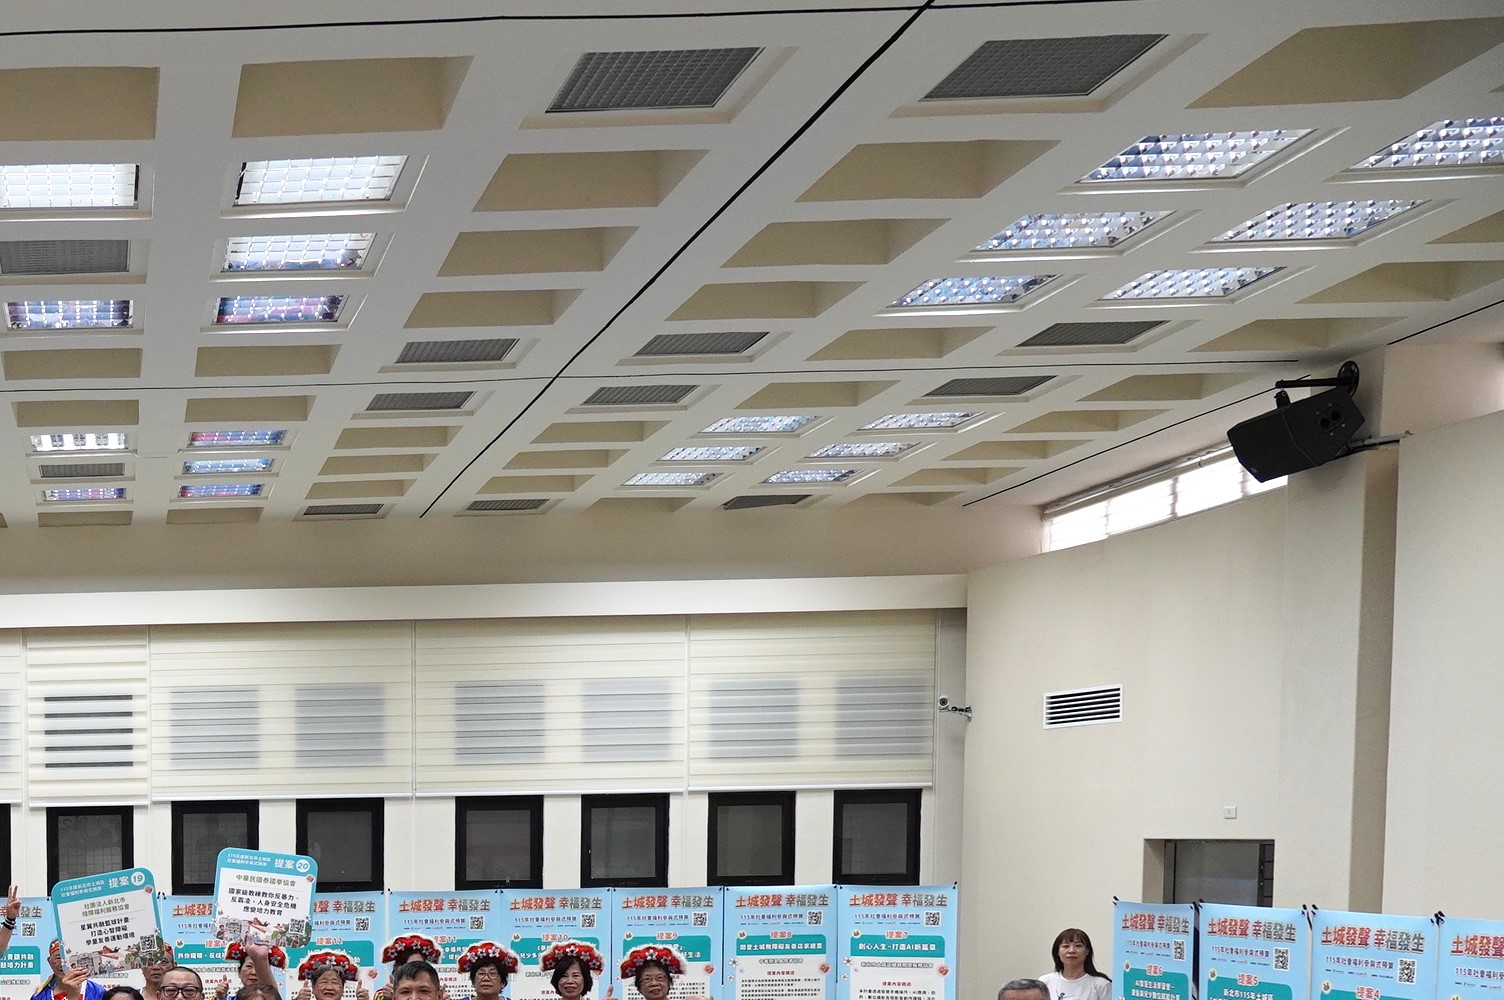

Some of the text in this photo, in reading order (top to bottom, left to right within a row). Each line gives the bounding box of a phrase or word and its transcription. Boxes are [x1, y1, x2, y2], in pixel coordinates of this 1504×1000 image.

[510, 898, 602, 910] 土城發聲 幸福發生
[849, 895, 947, 907] 土城發聲 幸福發生
[1122, 913, 1189, 934] 土城發聲 幸福發生
[1207, 919, 1296, 942] 土城發聲 幸福發生
[1321, 926, 1425, 953] 土城發聲 幸福發生
